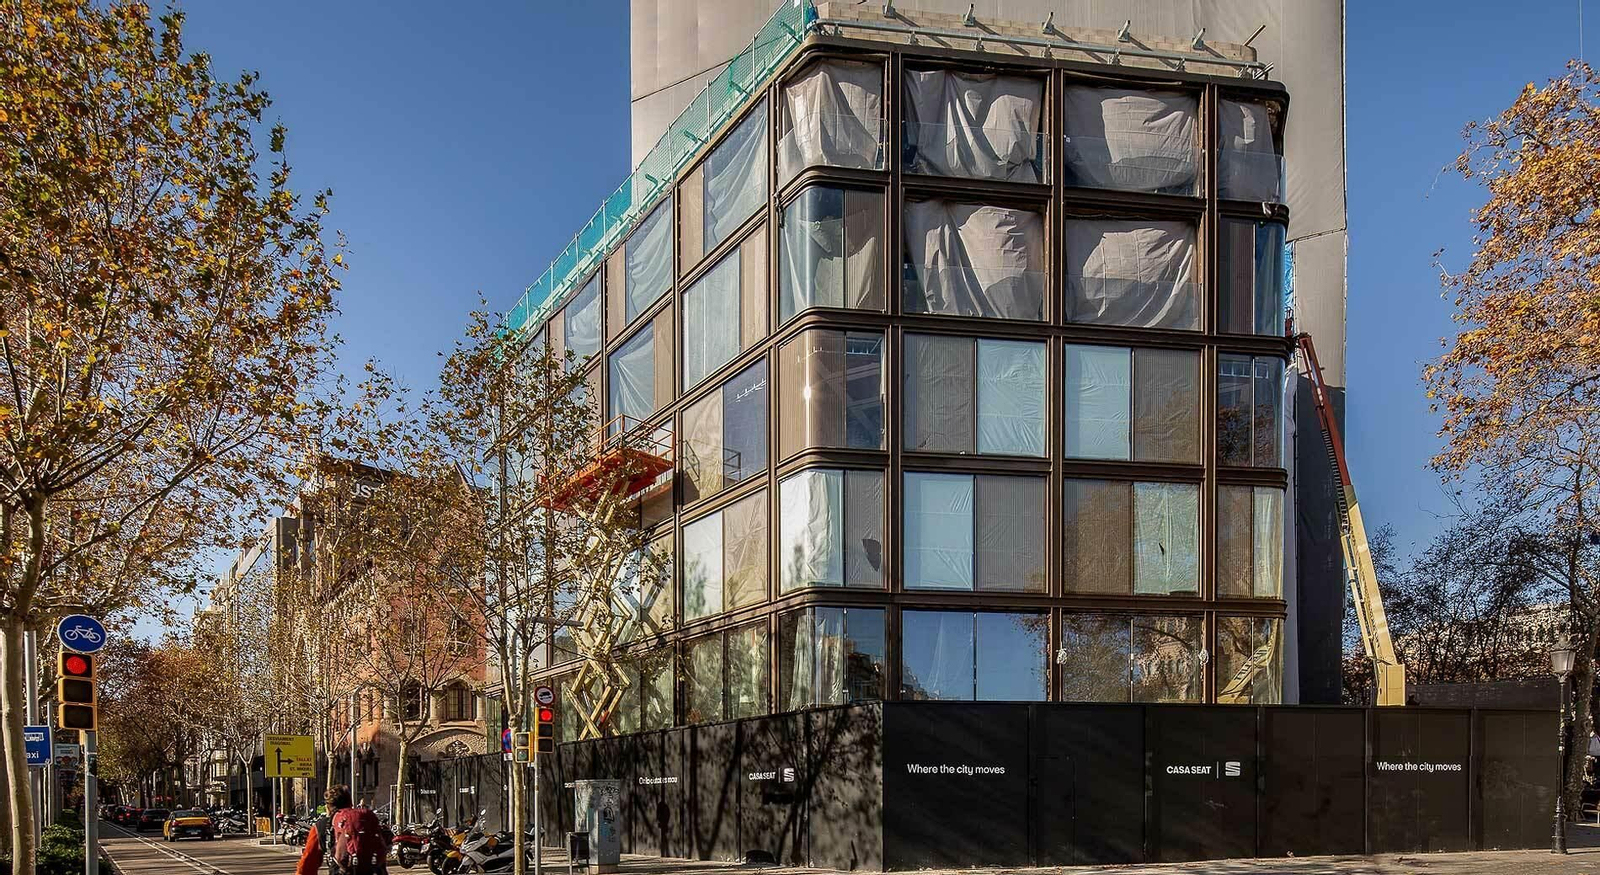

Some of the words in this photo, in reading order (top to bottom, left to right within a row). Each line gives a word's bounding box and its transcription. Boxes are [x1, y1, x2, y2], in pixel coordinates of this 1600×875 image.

[26, 751, 39, 759] axi
[906, 763, 939, 774] Where
[939, 763, 955, 774] the
[956, 764, 974, 776] city
[975, 766, 1005, 774] moves
[1166, 765, 1191, 774] CASA
[1191, 765, 1212, 774] SEAT
[1376, 761, 1404, 771] Where
[1404, 761, 1418, 771] the
[1419, 761, 1434, 773] city
[1435, 763, 1462, 771] moves
